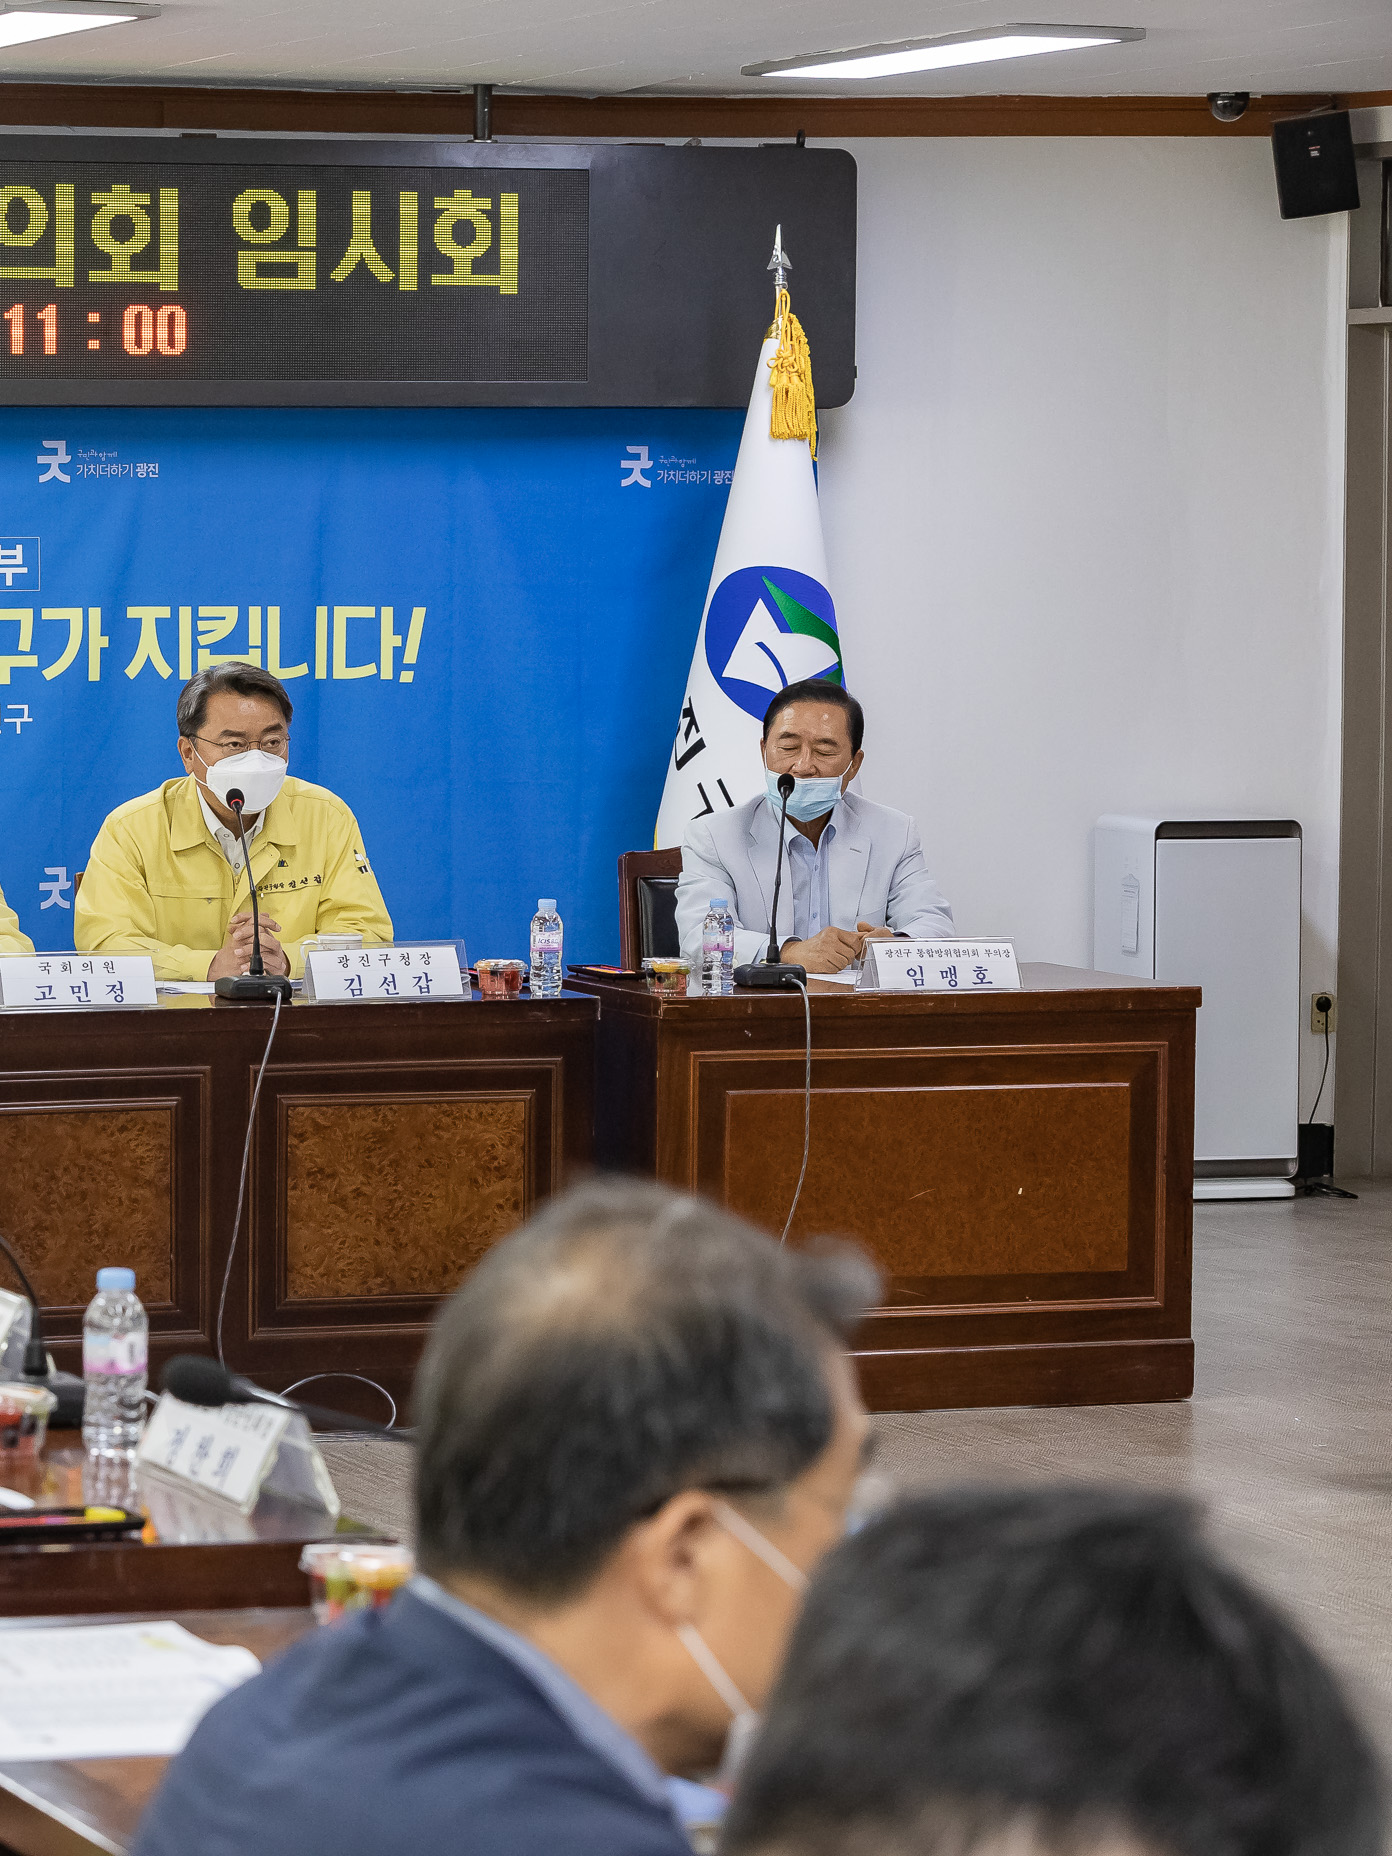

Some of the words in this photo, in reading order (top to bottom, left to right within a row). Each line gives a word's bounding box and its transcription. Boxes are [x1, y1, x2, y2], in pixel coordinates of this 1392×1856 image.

[232, 189, 519, 294] 임시회
[76, 463, 134, 479] 가치더하기
[135, 463, 159, 478] 광진
[657, 470, 712, 484] 가치더하기
[713, 470, 735, 485] 광진
[124, 605, 427, 683] 지킵니다!
[885, 948, 912, 959] 광진구
[906, 965, 993, 988] 임맹호
[34, 980, 125, 1003] 고민정
